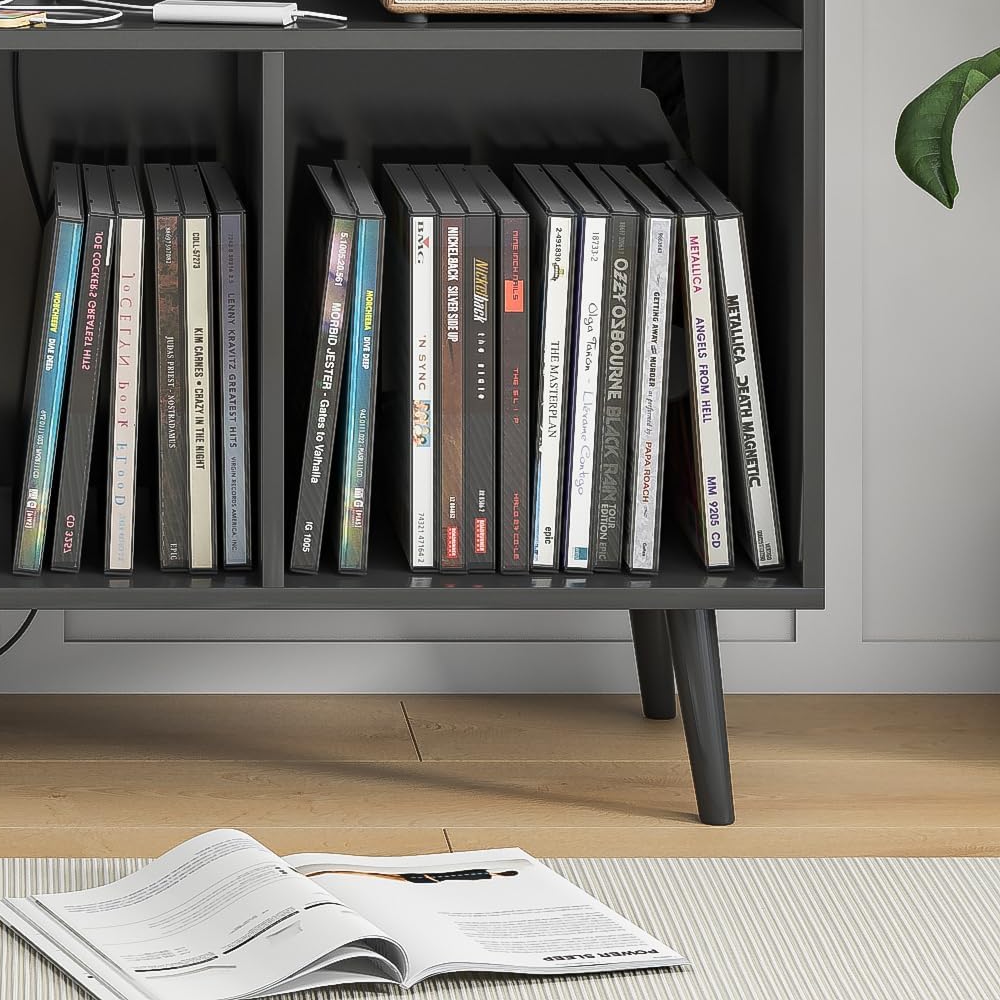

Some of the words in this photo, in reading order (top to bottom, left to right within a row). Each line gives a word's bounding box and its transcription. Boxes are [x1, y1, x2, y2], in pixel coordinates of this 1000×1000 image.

[192, 233, 200, 269] COLL-57273
[447, 226, 459, 281] NICKELBACK
[554, 227, 562, 261] 2-491830
[590, 232, 600, 262] 18733-2
[335, 232, 348, 287] 5.1005.20.561
[689, 236, 702, 293] METALLICA
[473, 257, 489, 323] Nickelback
[612, 258, 629, 304] OZZY
[228, 293, 236, 325] LENNY
[364, 290, 374, 331] MORCHEEBA
[447, 286, 459, 312] SILVER
[652, 292, 660, 322] GETTING
[327, 302, 341, 346] MORBID
[447, 314, 459, 331] SIDE
[584, 302, 598, 333] Olga
[726, 295, 746, 365] METALLICA
[165, 336, 174, 359] JUDAS
[194, 328, 203, 343] KIM
[228, 329, 236, 370] KRAVITZ
[363, 336, 371, 352] DIVE
[447, 332, 459, 342] UP
[477, 333, 486, 353] the
[695, 317, 707, 359] ANGELS
[194, 346, 204, 378] CARNES
[362, 353, 370, 370] DEEP
[550, 341, 560, 363] THE
[607, 305, 626, 400] OSBOURNE
[167, 361, 175, 387] PRIEST
[322, 348, 336, 390] JESTER
[418, 354, 427, 390] SYNC
[649, 357, 657, 387] MURDER
[699, 364, 709, 394] FROM
[194, 388, 204, 414] CRAZY
[228, 374, 237, 422] GREATEST
[548, 365, 559, 438] MASTERPLAN
[736, 374, 753, 418] DEATH
[168, 395, 177, 449] NOSTRADAMUS
[195, 416, 205, 425] IN
[317, 400, 330, 428] Gates
[702, 401, 712, 423] HELL
[195, 428, 205, 443] THE
[229, 427, 237, 448] HITS
[316, 431, 325, 442] to
[604, 405, 622, 458] BLACK
[195, 445, 205, 470] NIGHT
[310, 444, 325, 484] Valhalla
[644, 441, 652, 466] PAPA
[742, 421, 761, 488] MAGNETIC
[574, 445, 591, 496] Contigo
[601, 463, 619, 501] RAIN
[707, 476, 716, 495] MM
[642, 469, 651, 503] ROACH
[304, 521, 313, 531] IG
[600, 503, 608, 540] EDITION
[608, 504, 617, 529] TOUR
[708, 501, 719, 526] 9205
[302, 534, 312, 553] 1005
[543, 526, 553, 545] epic
[712, 532, 720, 548] CD
[170, 543, 178, 560] EPIC
